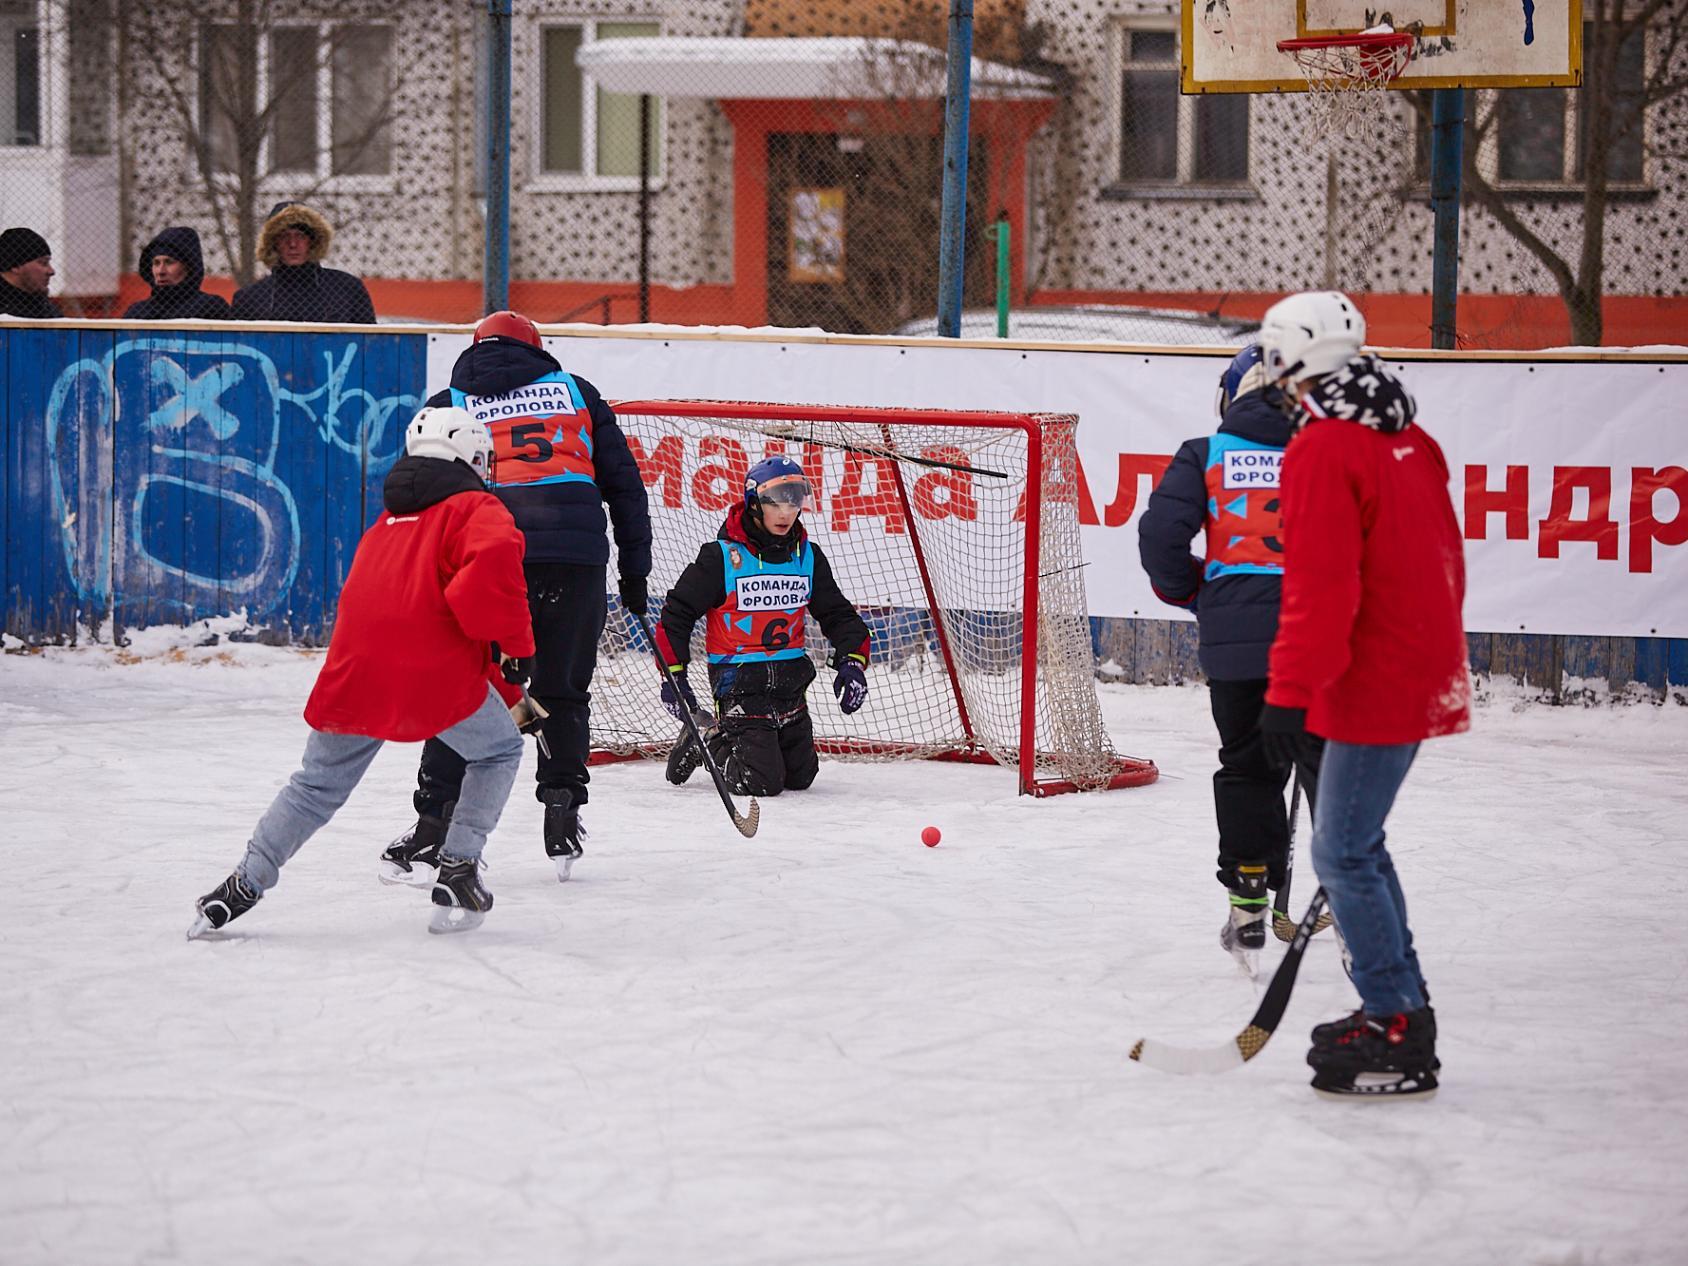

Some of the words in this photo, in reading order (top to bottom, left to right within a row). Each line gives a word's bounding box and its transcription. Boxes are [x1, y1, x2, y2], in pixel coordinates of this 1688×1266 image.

[471, 387, 564, 407] КОМАНДА
[475, 401, 568, 420] ФРОЛОВА
[511, 423, 553, 463] 5
[741, 580, 807, 592] КОМАНДА
[742, 593, 807, 607] ФРОЛОВА
[761, 618, 790, 650] 6
